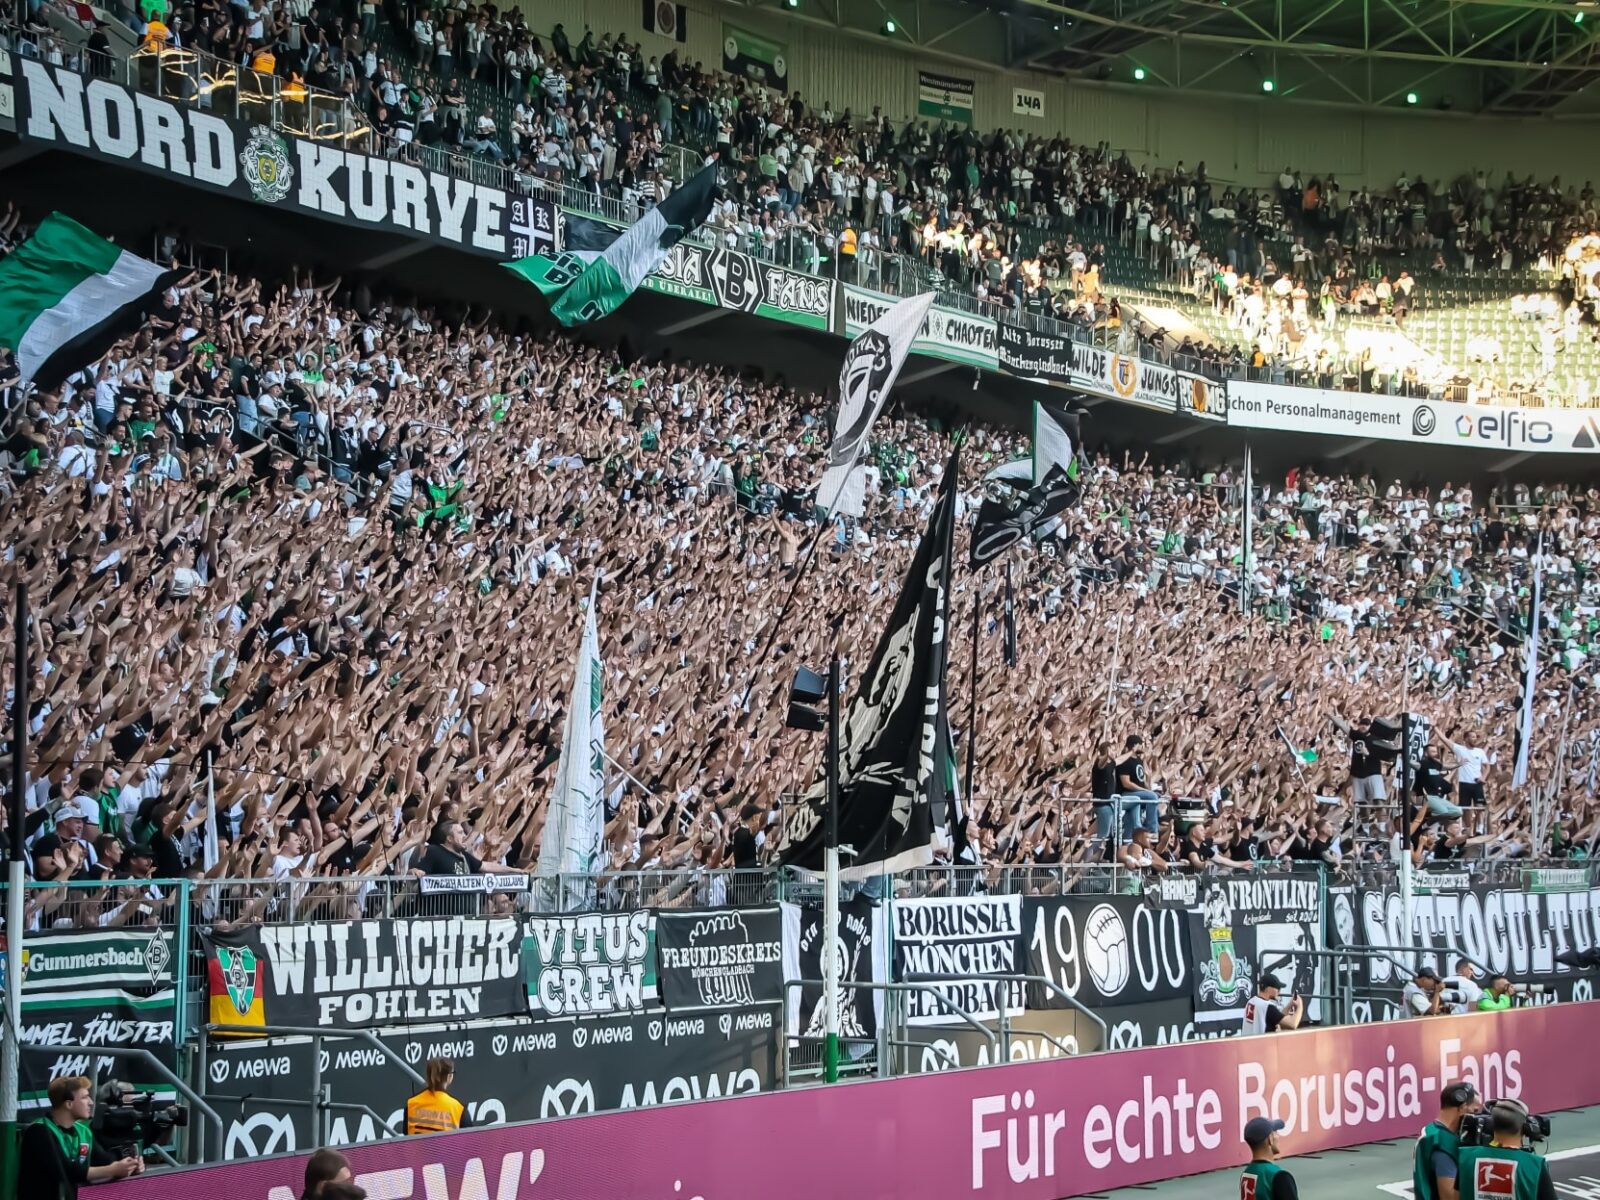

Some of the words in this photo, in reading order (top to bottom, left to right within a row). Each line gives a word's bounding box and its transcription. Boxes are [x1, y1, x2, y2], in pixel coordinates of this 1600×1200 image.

[1016, 94, 1041, 110] 14A
[21, 58, 238, 187] NORD
[296, 138, 506, 252] KURVE
[649, 244, 702, 286] SIA
[766, 268, 830, 315] FANS
[658, 278, 712, 302] ÜBERALL!
[945, 319, 999, 350] CHAOTEN
[1072, 347, 1107, 379] WILDE
[1140, 367, 1176, 396] JUNGS
[1266, 400, 1401, 426] Personalmanagement
[1477, 411, 1554, 448] elfio
[1228, 879, 1318, 911] FRONTLINE
[530, 909, 650, 965] VITUS
[897, 902, 1016, 937] BORUSSIA
[29, 947, 144, 972] Gummersbach
[260, 915, 520, 996] WILLICHER
[661, 940, 781, 969] FREUNDESKREIS
[902, 938, 1015, 975] MÖNCHEN
[318, 986, 482, 1025] FOHLEN
[538, 961, 645, 1015] CREW
[80, 1012, 174, 1046] JÄUSTER
[972, 1088, 1066, 1190] Für
[1083, 1075, 1223, 1169] echte
[1238, 1038, 1523, 1143] Borussia-Fans
